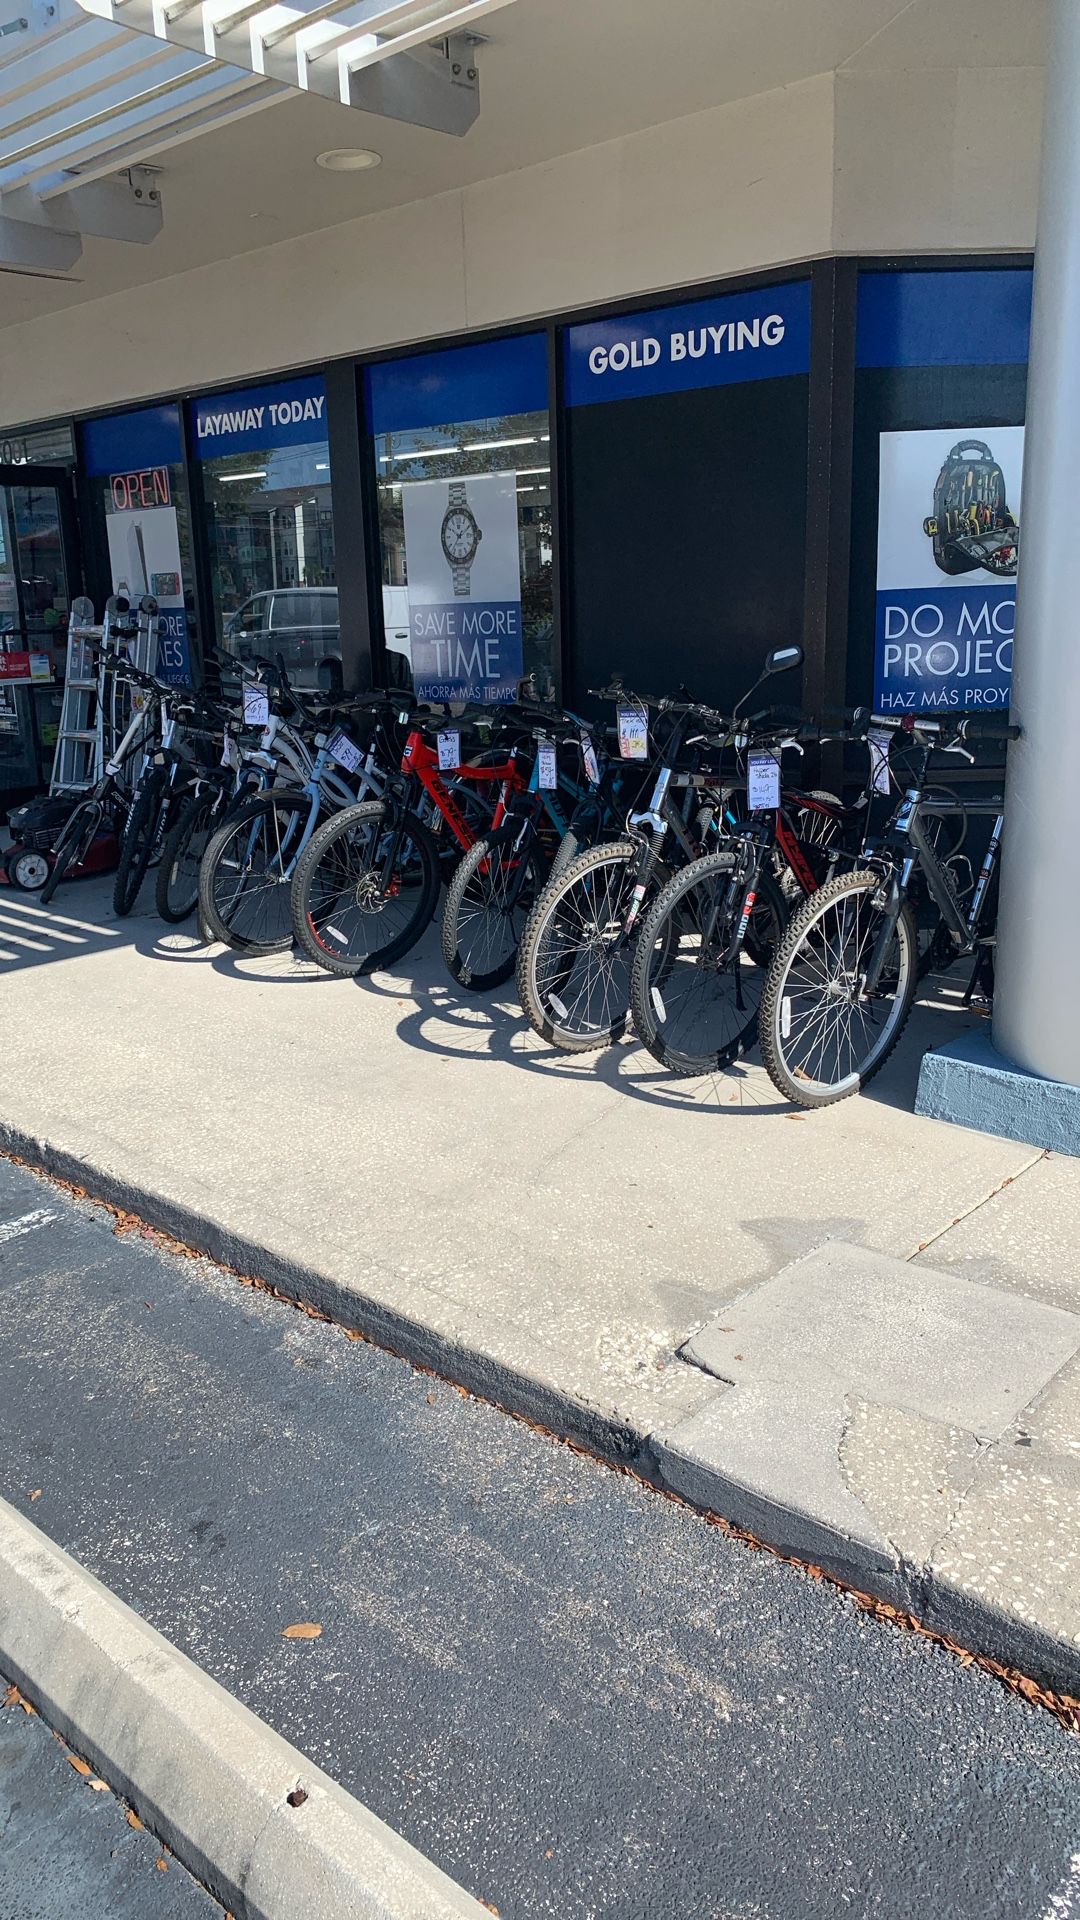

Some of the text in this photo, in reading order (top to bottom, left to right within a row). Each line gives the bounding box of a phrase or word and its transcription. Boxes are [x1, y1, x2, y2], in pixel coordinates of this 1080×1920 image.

[588, 314, 785, 375] GOLD BUYING
[197, 396, 325, 438] LAYAWAY TODAY
[113, 469, 168, 509] OPEN
[414, 610, 517, 636] SAVE MORE
[884, 603, 944, 640] DO
[430, 638, 501, 678] TIME
[418, 686, 456, 698] AHORRA
[459, 683, 481, 699] MÁS
[880, 691, 916, 709] HAZ
[921, 686, 959, 706] MÁS
